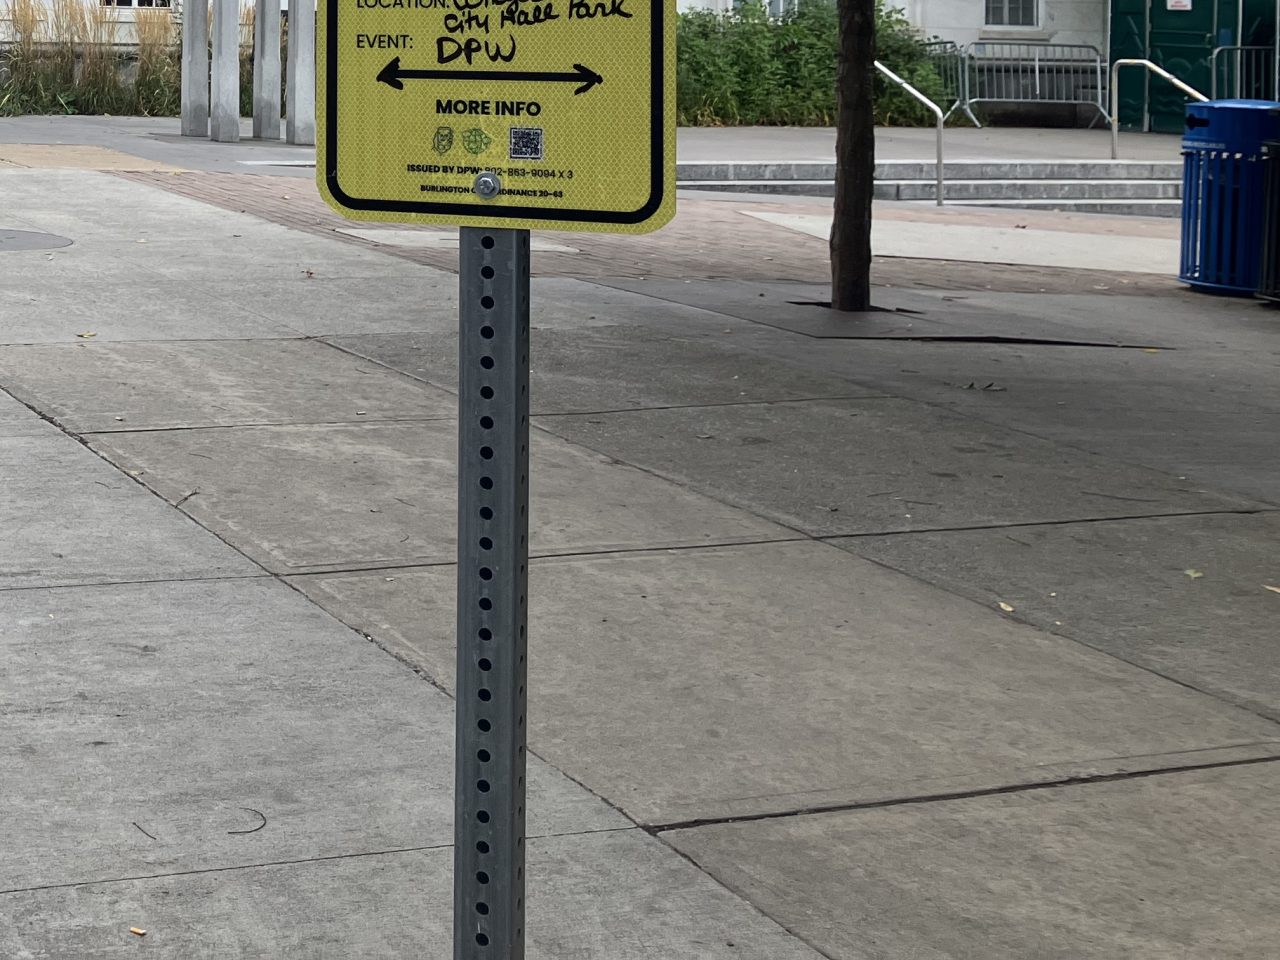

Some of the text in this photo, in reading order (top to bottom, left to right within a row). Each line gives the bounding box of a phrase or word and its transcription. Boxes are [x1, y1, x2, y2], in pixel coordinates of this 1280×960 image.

[356, 34, 413, 49] EVENT:
[436, 34, 516, 65] DPW
[436, 99, 541, 117] MORE INFO
[407, 164, 440, 173] ISSUED
[442, 165, 455, 174] BY
[420, 185, 470, 194] BURLINGTON
[538, 189, 563, 198] 20-63
